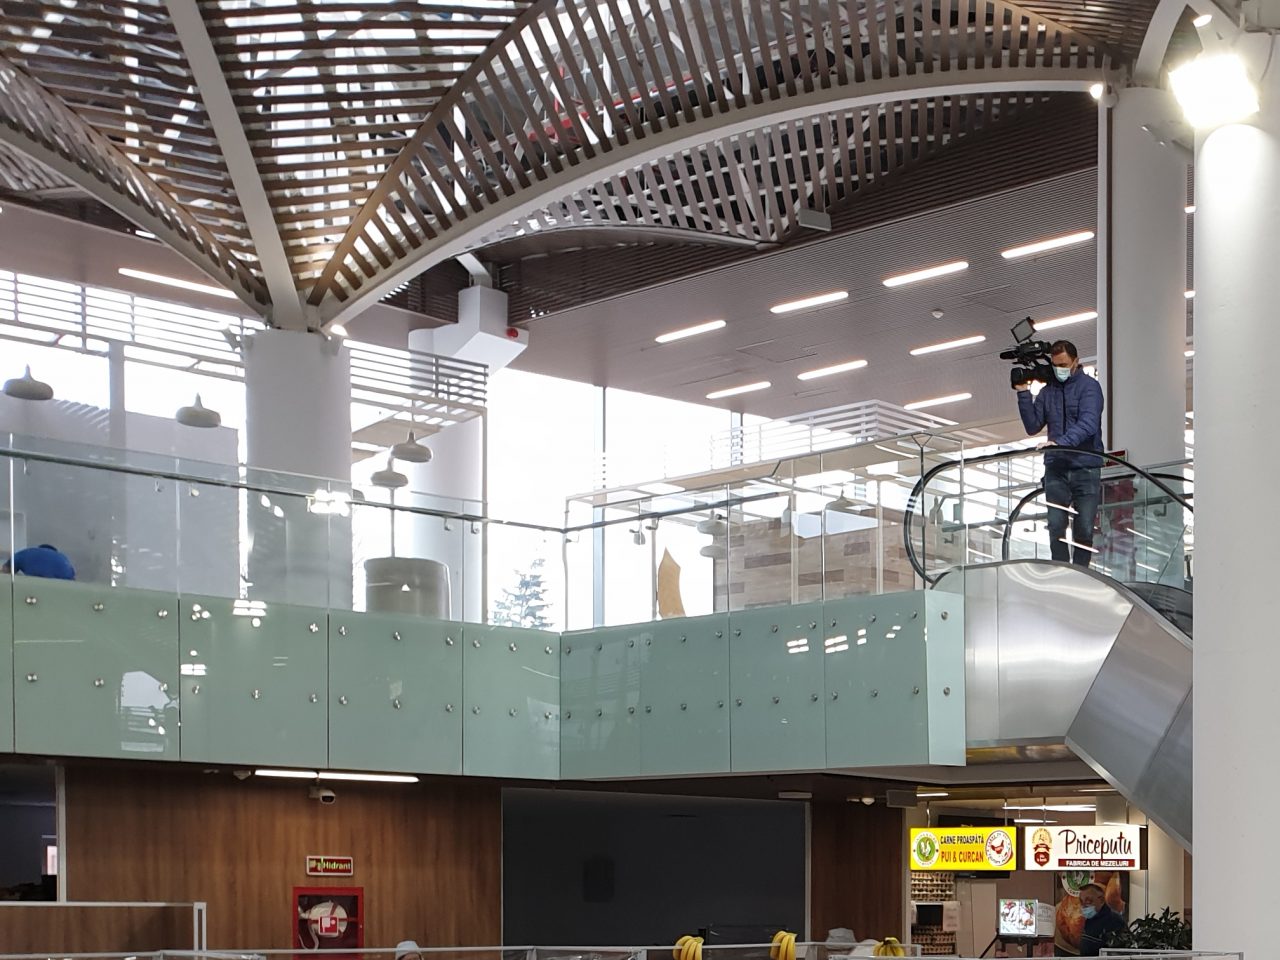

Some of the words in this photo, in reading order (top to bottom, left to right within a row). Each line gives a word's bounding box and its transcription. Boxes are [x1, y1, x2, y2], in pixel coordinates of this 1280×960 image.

[940, 835, 956, 845] CARNE
[1057, 829, 1132, 860] Priceputu
[941, 851, 952, 863] PUI
[958, 851, 984, 863] CURCAN
[323, 860, 351, 870] Hidrant
